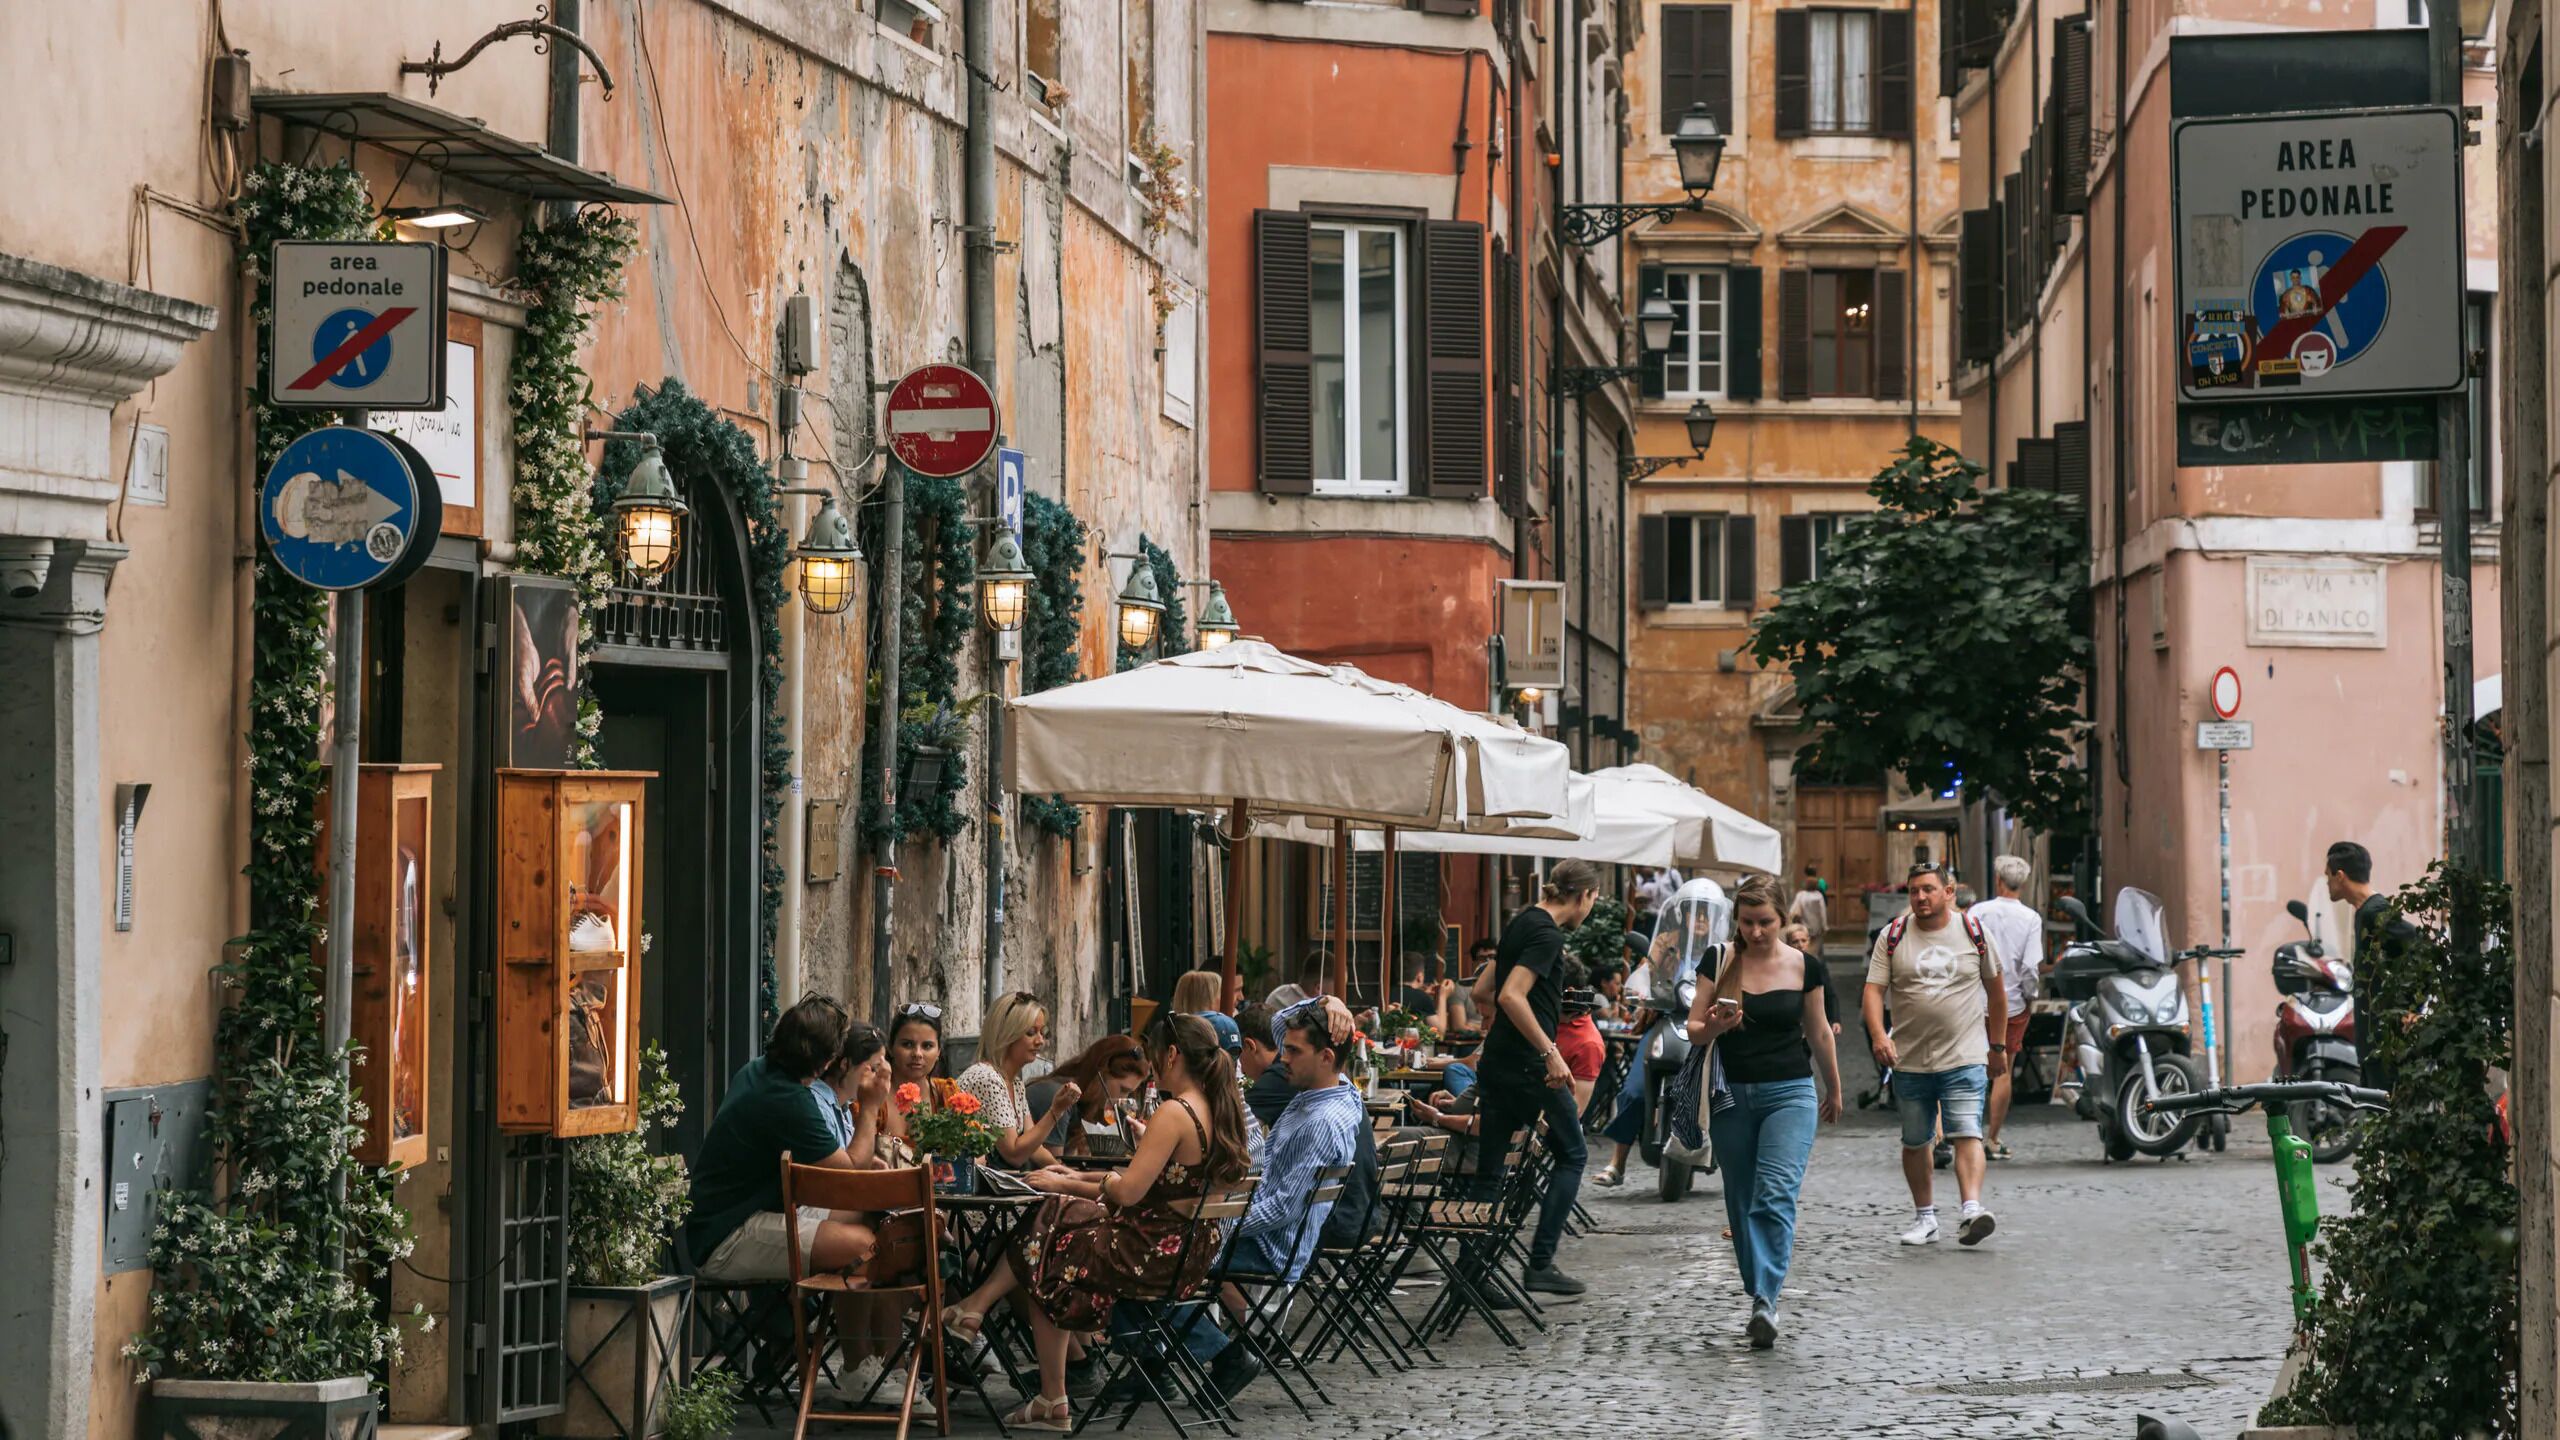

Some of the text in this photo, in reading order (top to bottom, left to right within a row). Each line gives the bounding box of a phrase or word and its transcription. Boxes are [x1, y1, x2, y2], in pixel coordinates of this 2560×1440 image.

[2277, 138, 2357, 172] AREA
[2241, 182, 2394, 220] PEDONALE
[330, 256, 377, 270] area
[303, 277, 404, 298] pedonale
[2304, 574, 2332, 593] VIA
[2265, 608, 2370, 628] DI PANICO
